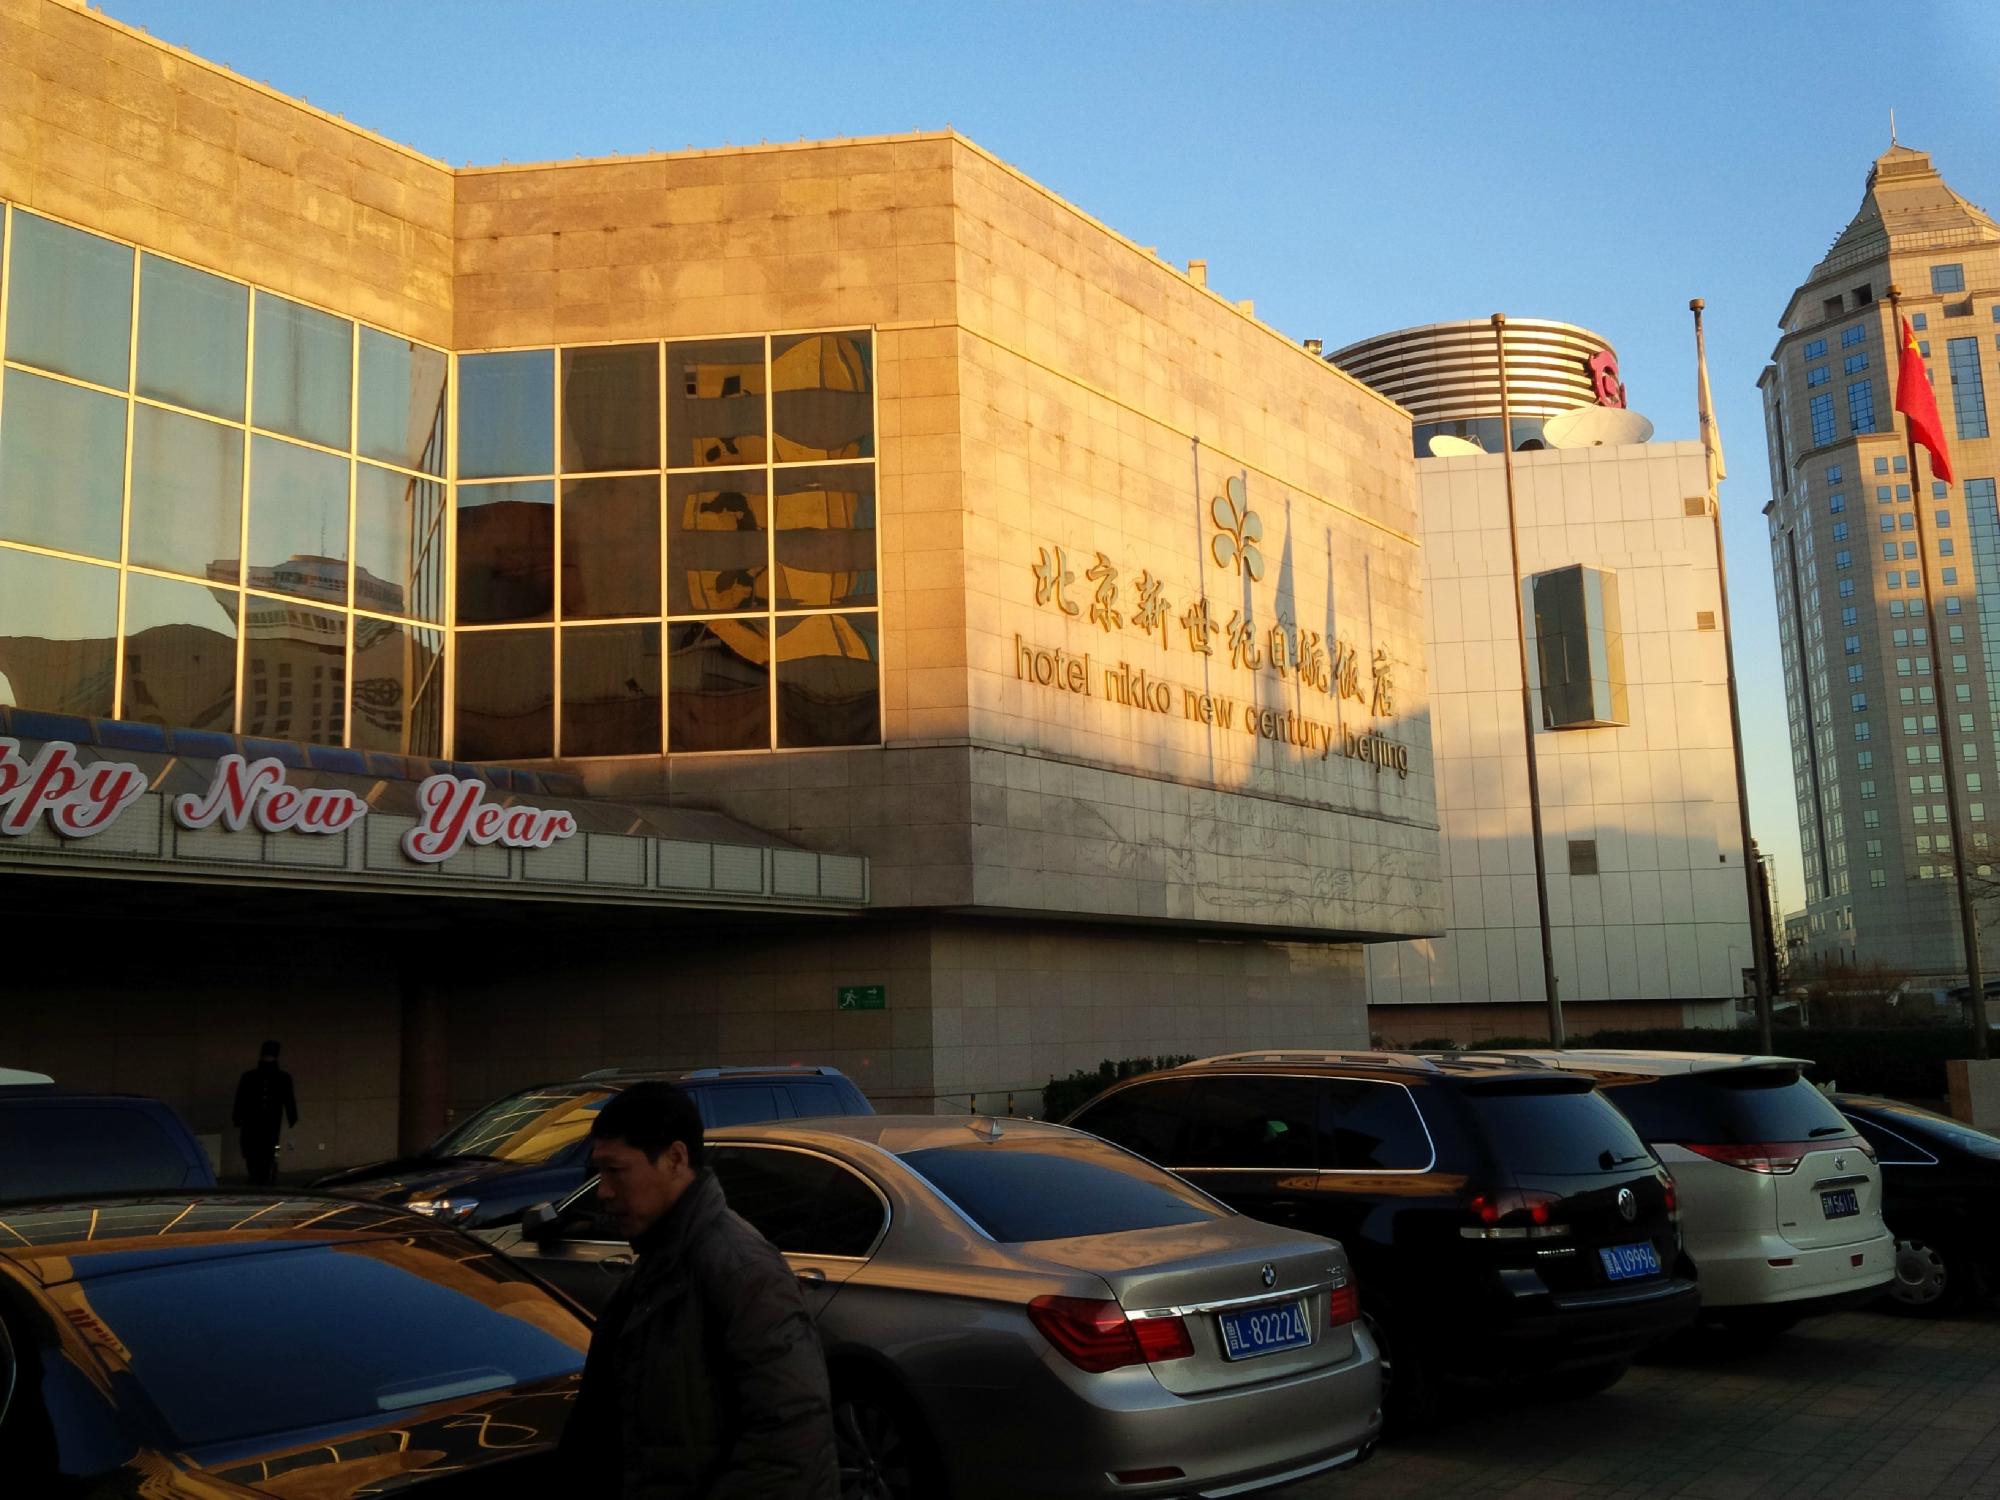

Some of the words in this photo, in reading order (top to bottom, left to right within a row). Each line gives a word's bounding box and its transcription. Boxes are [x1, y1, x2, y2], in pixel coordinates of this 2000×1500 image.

[1033, 545, 1394, 717] 北京新世纪日航饭店
[1014, 634, 1090, 697] hotel
[1104, 662, 1171, 714] nikko
[1184, 687, 1233, 730] new
[1245, 704, 1332, 761] century
[1343, 722, 1409, 780] beijing
[178, 757, 362, 830] New
[407, 775, 575, 858] Year
